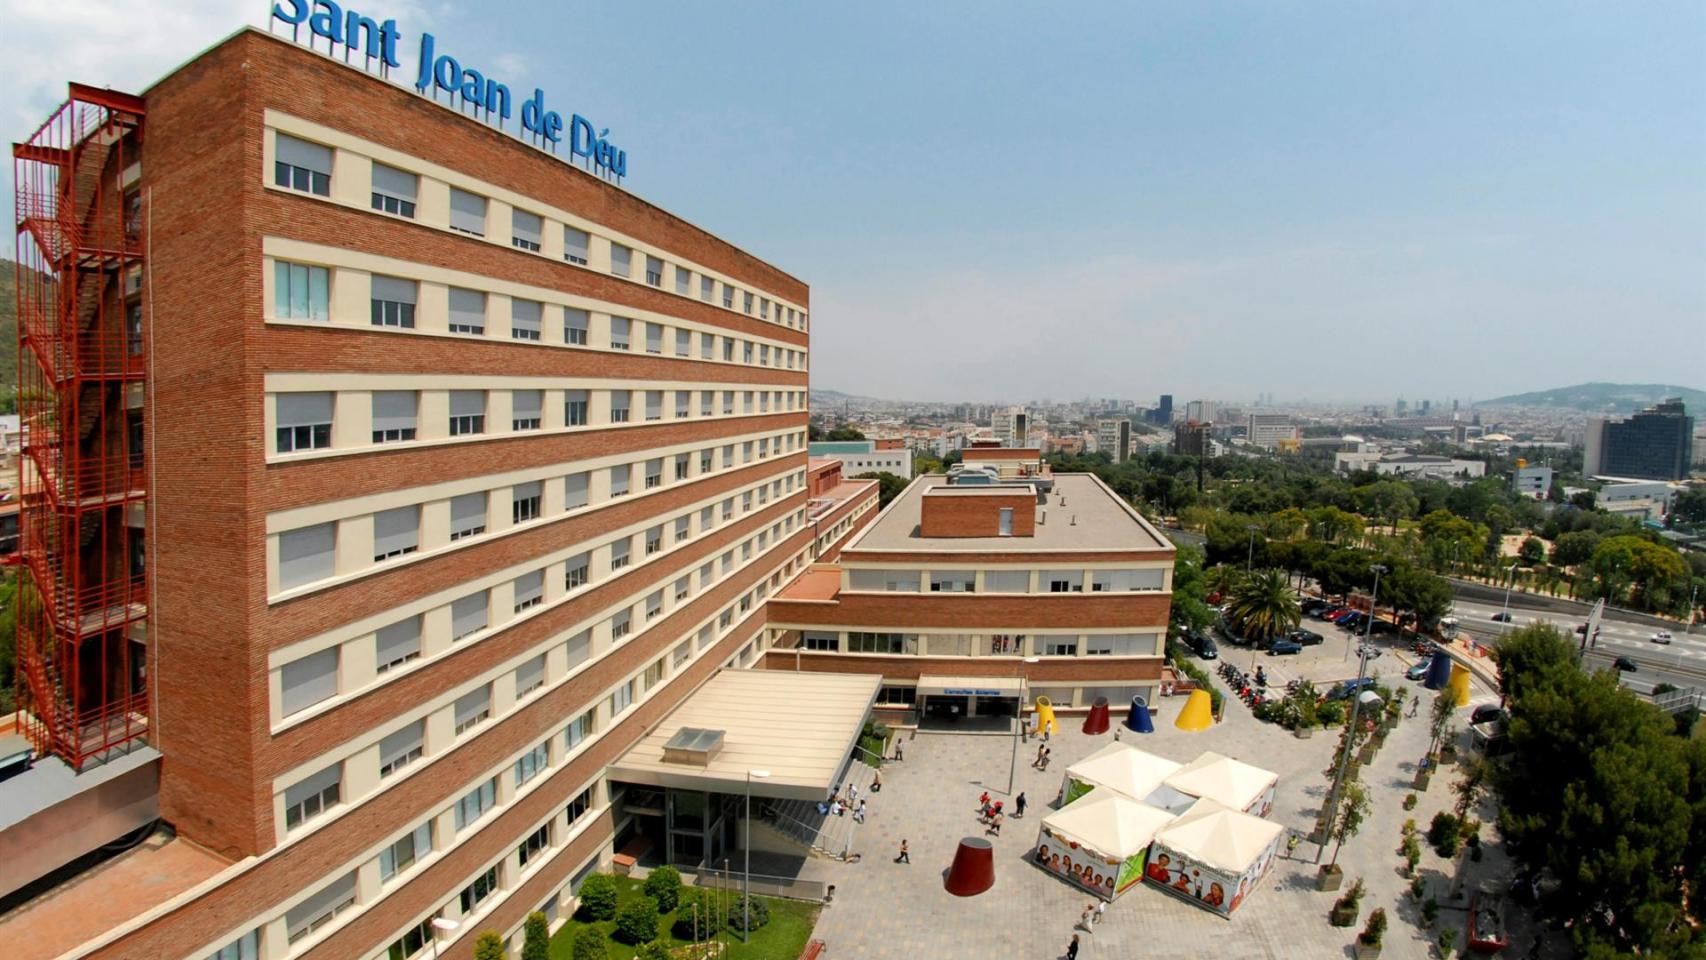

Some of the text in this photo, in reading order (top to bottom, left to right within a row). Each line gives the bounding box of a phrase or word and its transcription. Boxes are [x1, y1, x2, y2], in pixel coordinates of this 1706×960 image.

[415, 33, 511, 119] Joan
[521, 88, 563, 142] de
[571, 113, 626, 177] Déu
